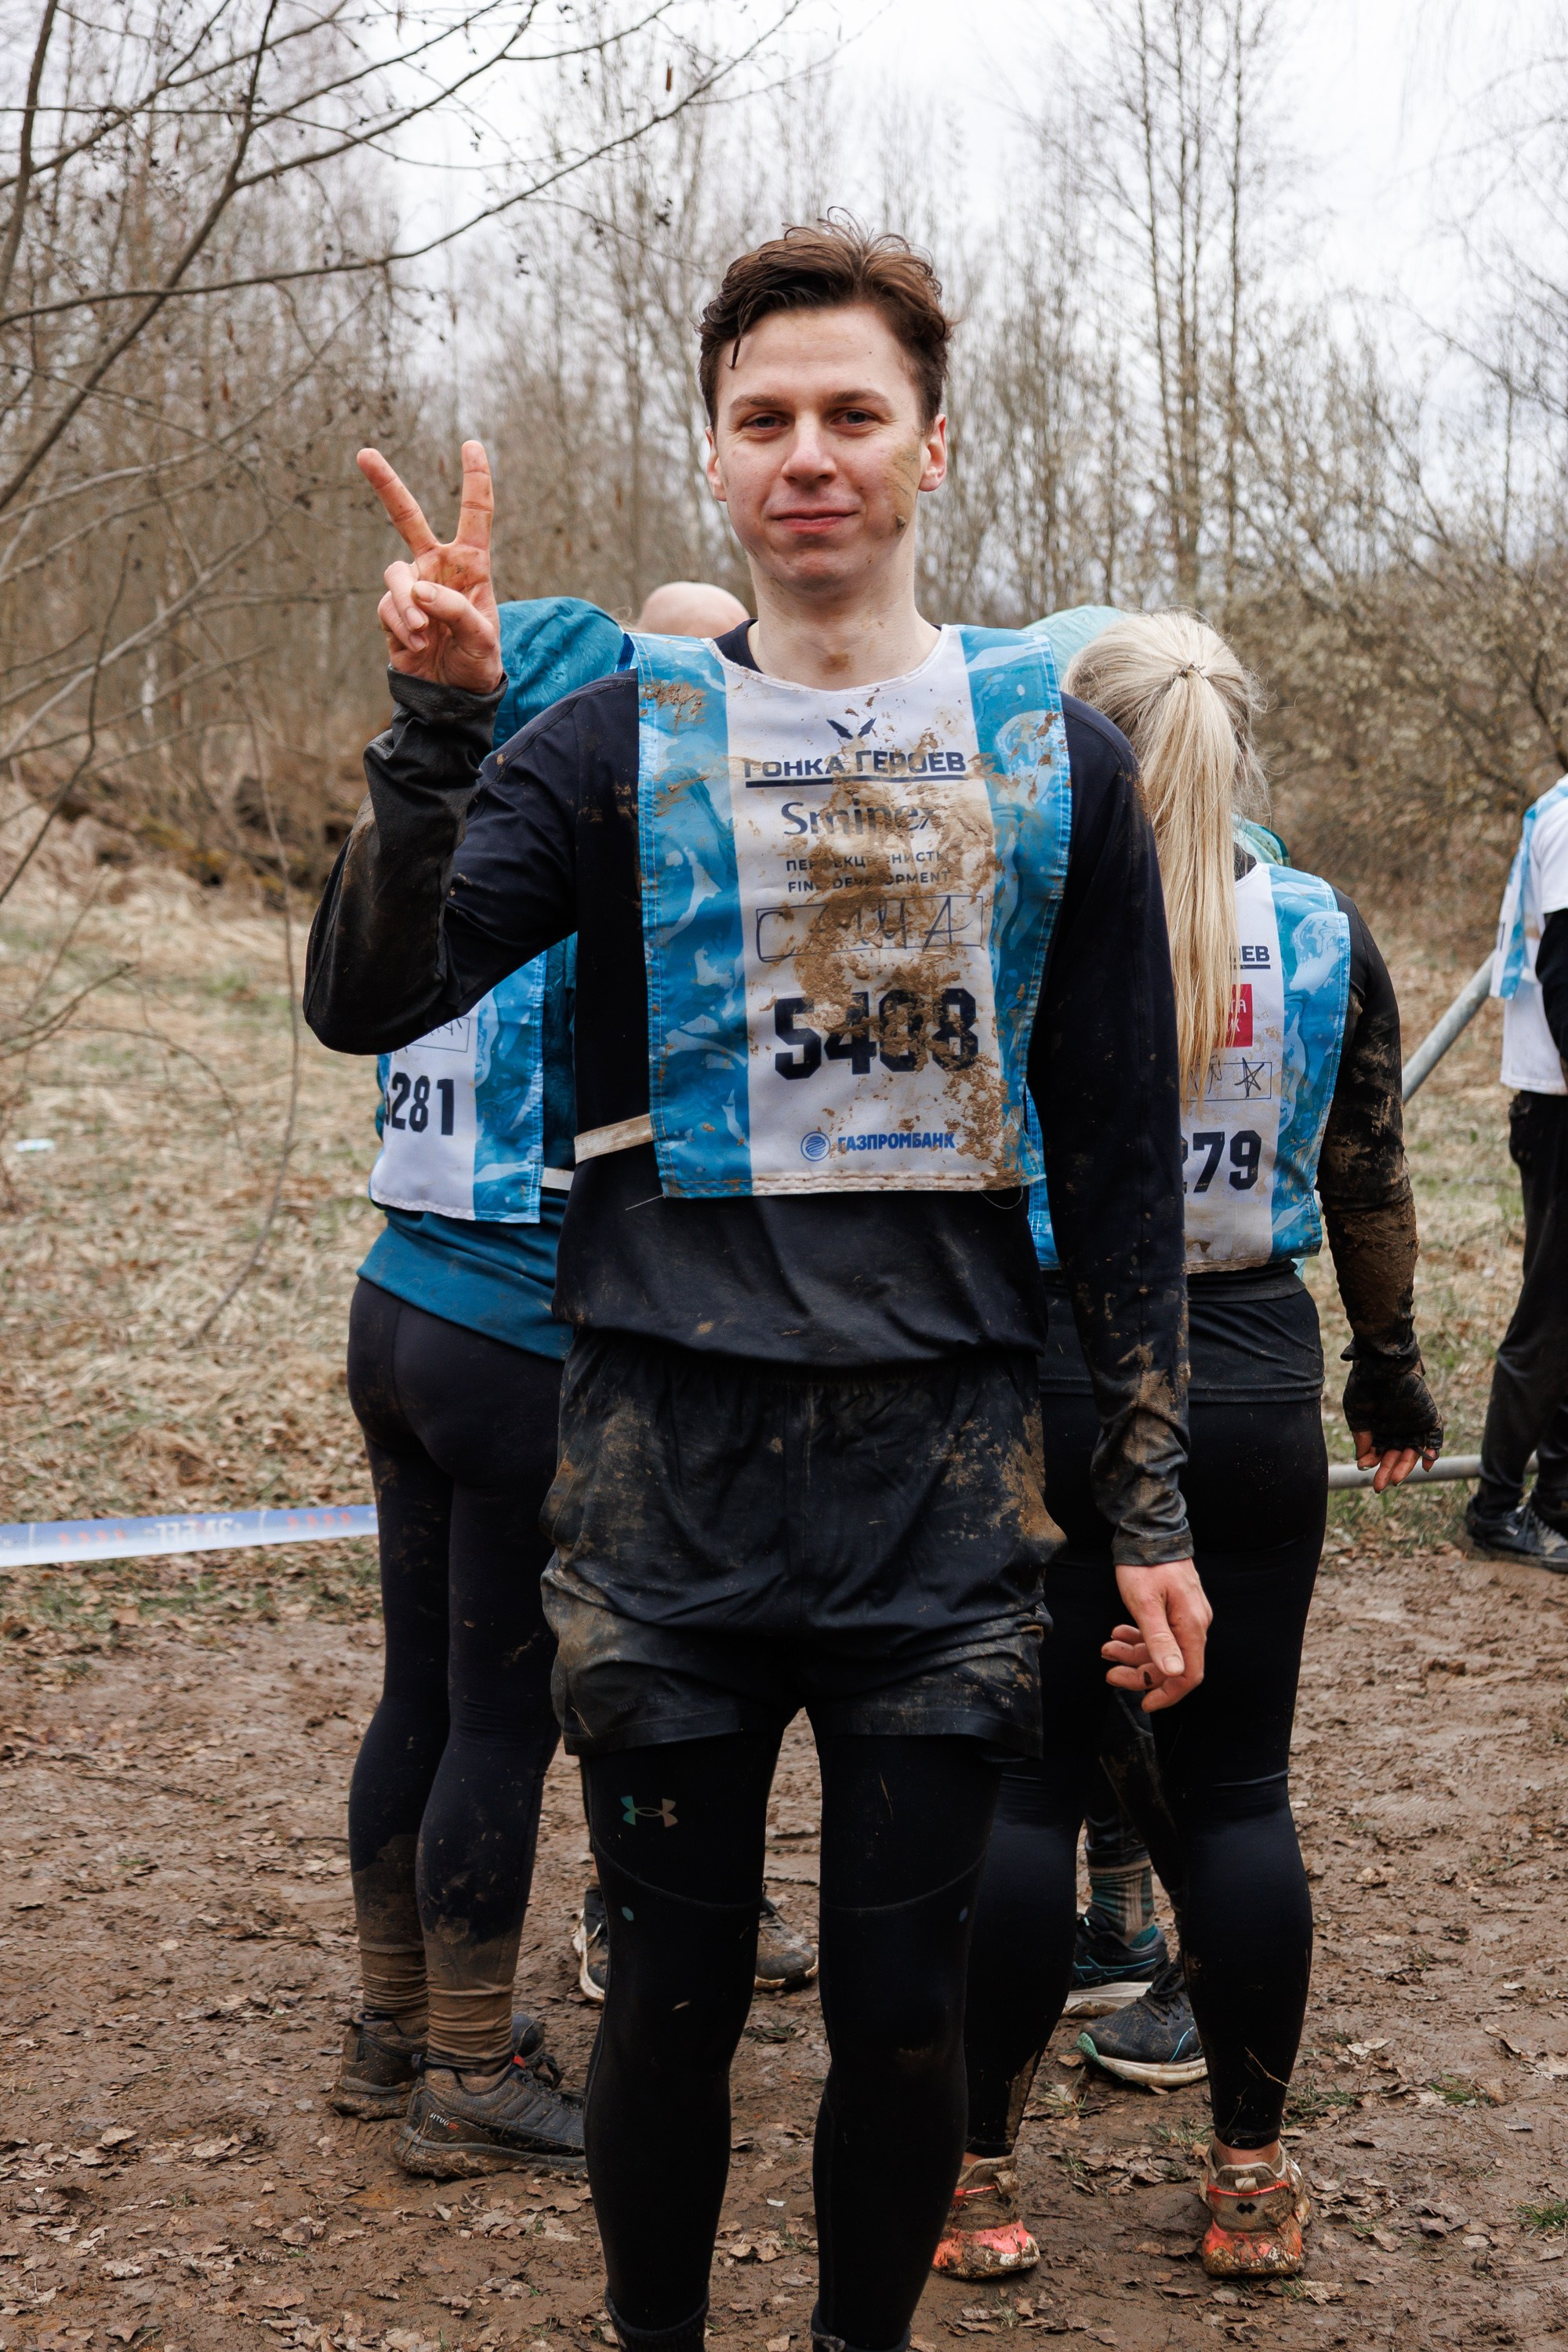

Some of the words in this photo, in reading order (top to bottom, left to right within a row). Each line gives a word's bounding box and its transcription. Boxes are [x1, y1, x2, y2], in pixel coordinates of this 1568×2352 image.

[743, 755, 846, 779] ГОНКА
[855, 750, 967, 775] ГЕРОЕВ
[787, 880, 823, 893] FIN
[386, 1072, 455, 1136] 281
[837, 1131, 956, 1152] ГАЗПРОМБАНК
